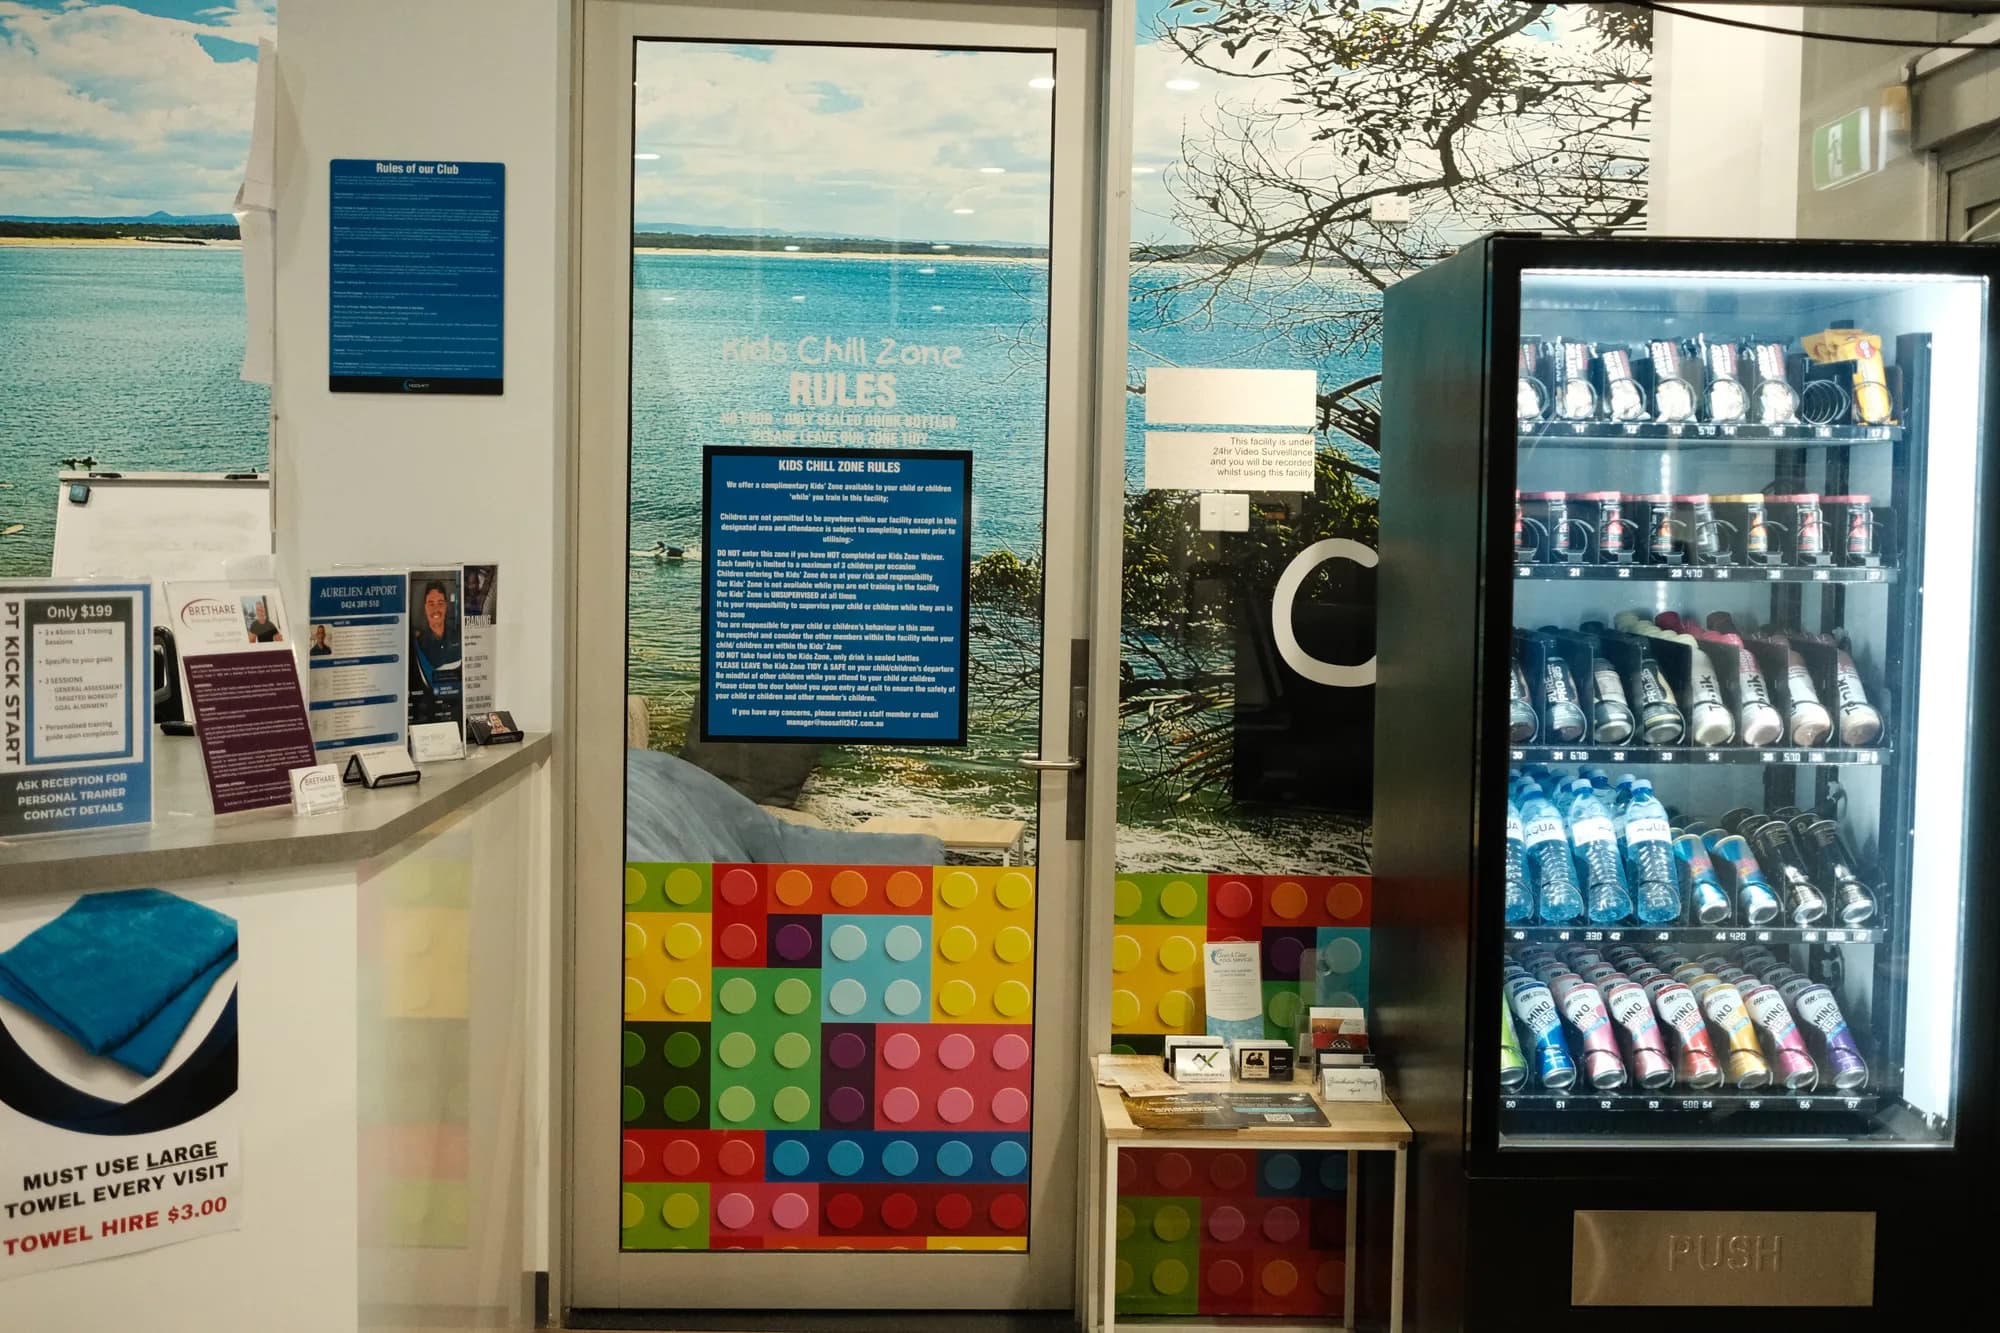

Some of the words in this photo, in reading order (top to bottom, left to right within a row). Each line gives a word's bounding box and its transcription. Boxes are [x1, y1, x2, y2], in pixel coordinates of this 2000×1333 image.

[376, 163, 403, 173] Rules
[406, 163, 416, 174] of
[419, 165, 434, 174] our
[437, 164, 459, 174] Club
[722, 335, 787, 364] Kids
[800, 336, 868, 366] Chill
[876, 338, 964, 369] Zone
[790, 371, 896, 407] RULES
[784, 413, 812, 426] ONLY
[818, 414, 861, 426] SEALED
[751, 430, 796, 442] PLEASE
[800, 430, 837, 442] LEAVE
[868, 432, 897, 444] ZONE
[1231, 437, 1248, 445] This
[1251, 437, 1277, 447] facility
[1289, 438, 1313, 446] under
[1213, 447, 1232, 455] 24hr
[1262, 448, 1312, 456] Surveillance
[778, 460, 802, 471] KIDS
[806, 461, 834, 471] CHILL
[837, 461, 864, 472] ZONE
[867, 462, 900, 472] RULES
[1244, 469, 1266, 478] using
[1286, 469, 1312, 478] facility
[726, 480, 736, 488] We
[738, 480, 753, 489] offer
[760, 481, 808, 491] complimentary
[827, 482, 843, 490] Zone
[844, 482, 874, 491] available
[875, 483, 882, 491] to
[883, 484, 897, 493] your
[899, 483, 915, 492] child
[924, 484, 951, 492] children
[812, 495, 823, 503] you
[849, 494, 862, 502] this
[717, 549, 726, 557] DO
[727, 549, 740, 557] NOT
[790, 550, 795, 558] if
[797, 552, 808, 560] you
[826, 551, 839, 559] NOT
[841, 551, 875, 561] completed
[888, 552, 902, 560] Kids
[903, 552, 919, 560] Zone
[320, 586, 362, 598] AURELIEN
[365, 585, 397, 596] APPORT
[770, 591, 819, 599] UNSUPERVISED
[838, 592, 856, 600] times
[5, 602, 19, 628] PT
[47, 605, 77, 620] Only
[81, 605, 112, 618] $199
[189, 604, 236, 616] BRETHARE
[5, 636, 19, 689] KICK
[5, 695, 20, 764] START
[1513, 752, 1523, 760] 30
[1554, 752, 1563, 760] 31
[1614, 752, 1624, 760] 32
[1708, 753, 1719, 761] 34
[16, 779, 38, 791] ASK
[42, 774, 103, 789] RECEPTION
[106, 772, 127, 783] FOR
[18, 792, 77, 806] PERSONAL
[80, 788, 126, 800] TRAINER
[24, 807, 76, 820] CONTACT
[80, 803, 123, 816] DETAILS
[1560, 932, 1569, 940] 41
[1610, 932, 1620, 940] 42
[1716, 932, 1726, 940] 44
[1506, 1101, 1516, 1109] 50
[1556, 1101, 1565, 1109] 51
[1601, 1101, 1611, 1109] 52
[1649, 1101, 1659, 1109] 53
[1702, 1101, 1712, 1109] 54
[1800, 1101, 1810, 1109] 56
[1848, 1101, 1858, 1109] 57
[23, 1164, 88, 1191] MUST
[96, 1156, 139, 1177] USE
[147, 1140, 218, 1168] LARGE
[5, 1191, 85, 1218] TOWEL
[93, 1175, 165, 1202] EVERY
[173, 1162, 229, 1186] VISIT
[4, 1226, 93, 1255] TOWEL
[101, 1211, 159, 1236] HIRE
[167, 1196, 227, 1224] $3.00
[1668, 1234, 1784, 1272] PUSH
